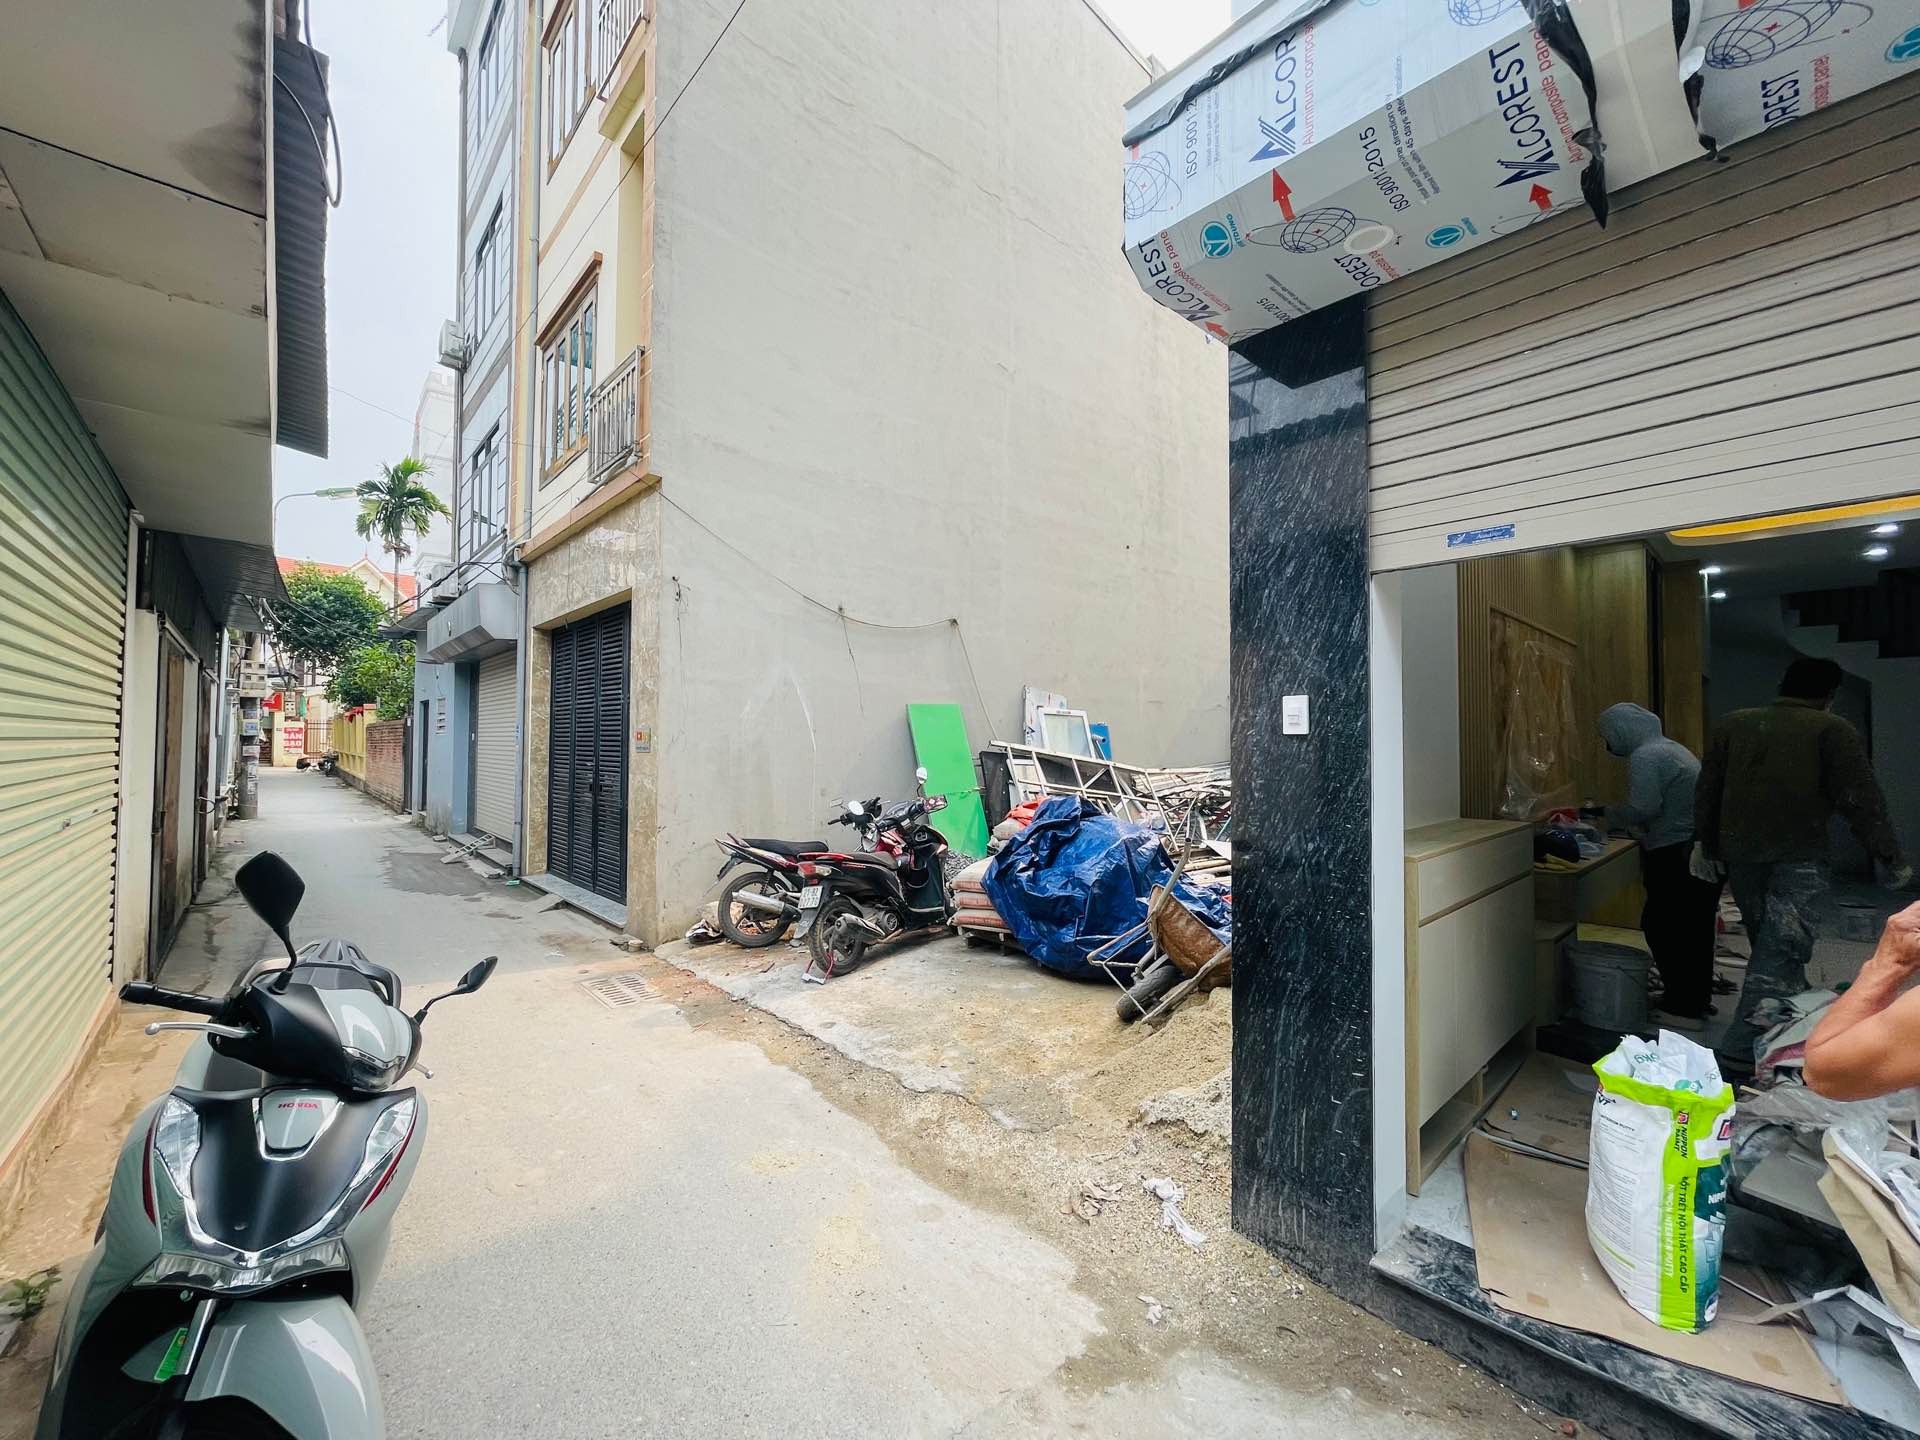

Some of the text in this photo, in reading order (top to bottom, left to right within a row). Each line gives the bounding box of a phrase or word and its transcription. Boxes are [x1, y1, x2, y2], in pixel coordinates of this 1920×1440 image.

[1303, 81, 1315, 146] Aluminum
[1489, 41, 1560, 188] ALCOREST
[1539, 75, 1569, 126] composite
[1387, 110, 1402, 147] direction
[1401, 116, 1413, 138] days
[1405, 138, 1414, 149] 45
[1185, 151, 1198, 179] ISO
[1359, 126, 1411, 213] ISO 9001:2015
[1396, 147, 1406, 162] one
[1137, 239, 1222, 322] ALCOREST
[278, 1102, 319, 1110] HONDA
[1680, 1126, 1688, 1159] NIPPON
[1679, 1255, 1688, 1274] CAO
